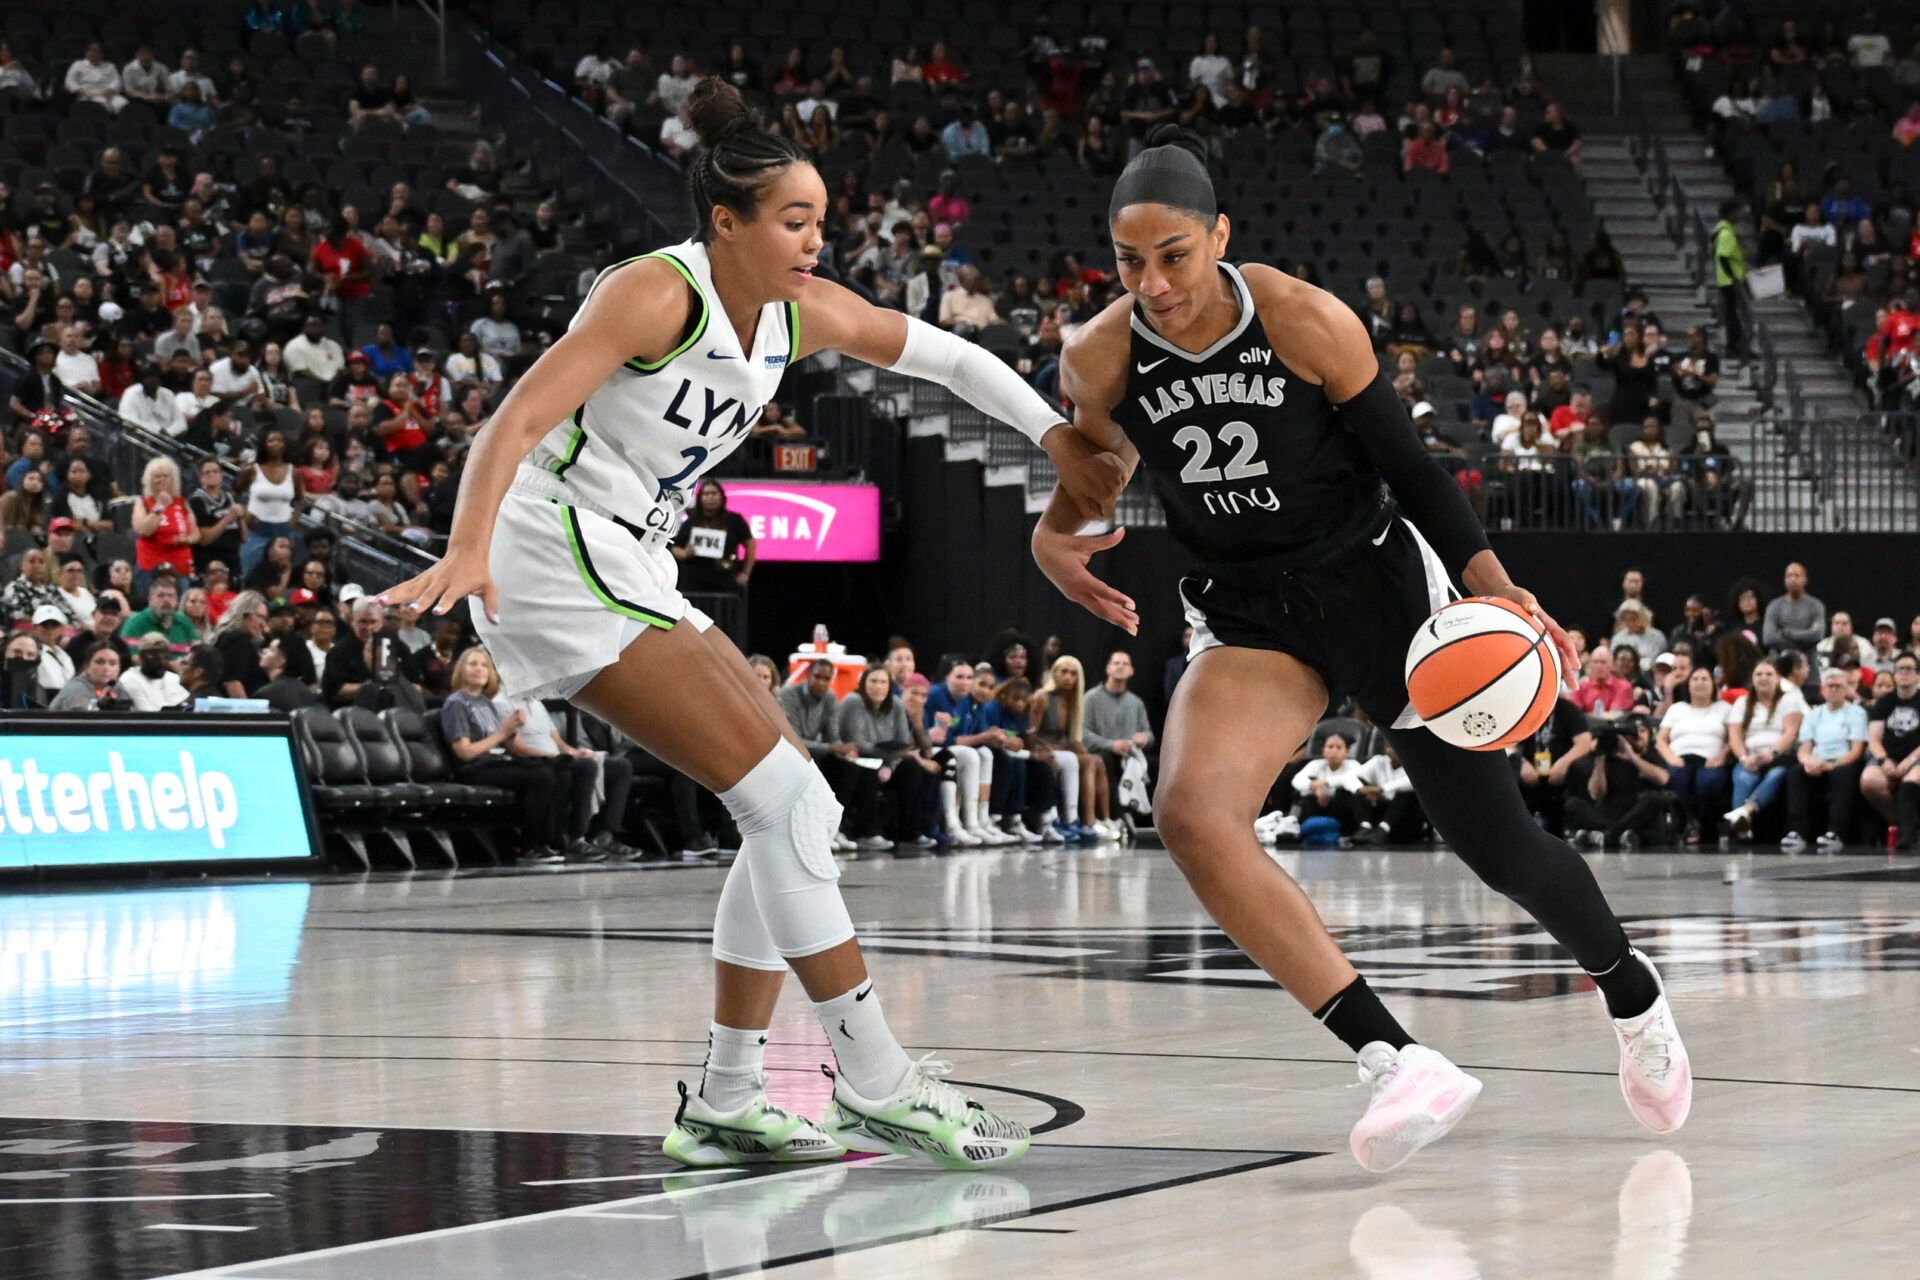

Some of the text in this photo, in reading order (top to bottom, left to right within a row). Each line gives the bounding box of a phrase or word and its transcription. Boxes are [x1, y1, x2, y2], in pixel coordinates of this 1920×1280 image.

[1239, 347, 1272, 365] ally
[663, 378, 764, 439] LYN
[1138, 372, 1286, 424] LAS VEGAS
[657, 445, 709, 490] 2
[782, 447, 809, 470] EXIT
[1172, 421, 1268, 483] 22
[751, 515, 812, 540] ENA
[0, 750, 238, 848] tterhelp
